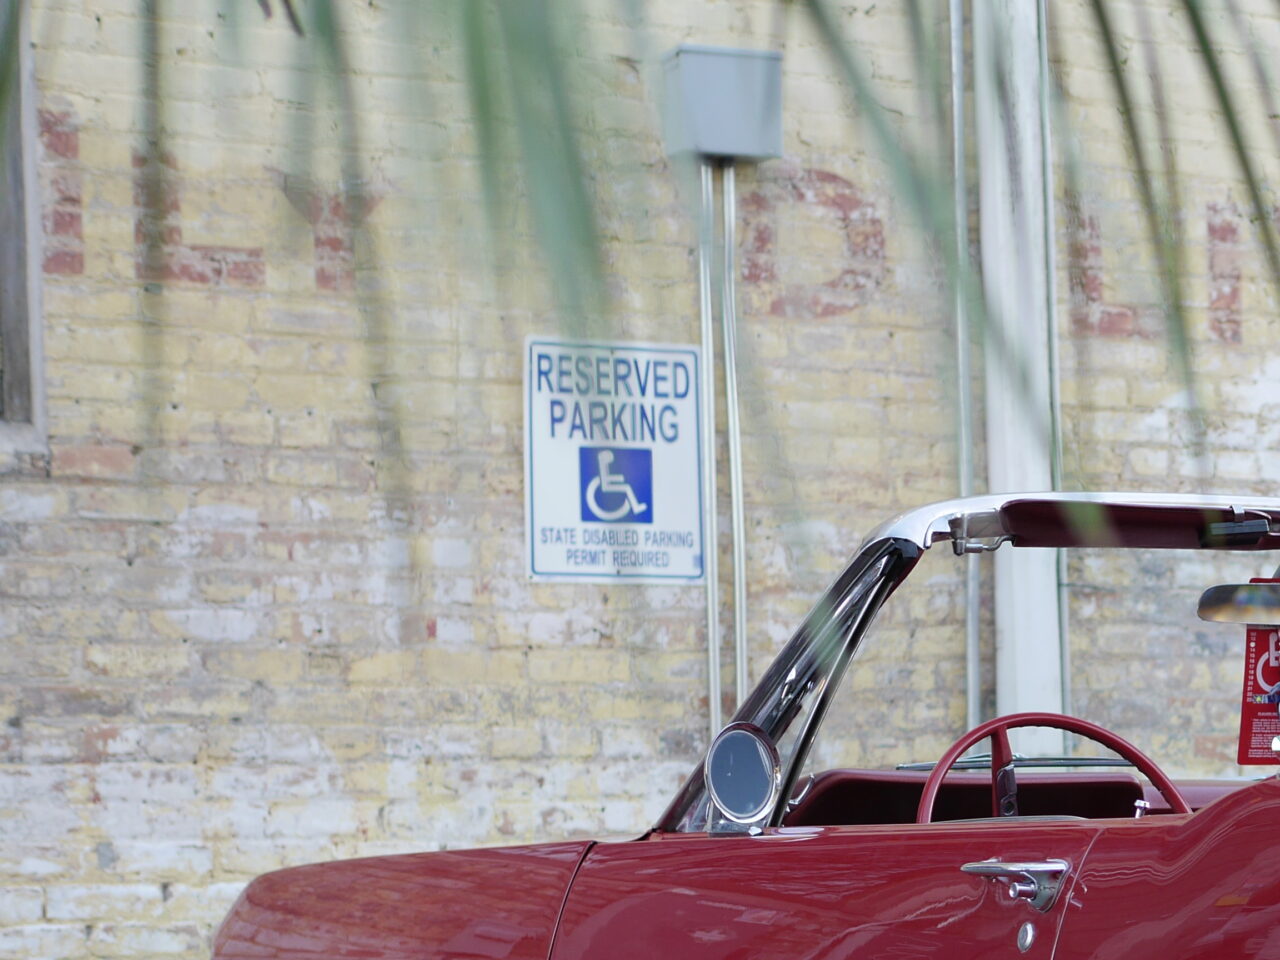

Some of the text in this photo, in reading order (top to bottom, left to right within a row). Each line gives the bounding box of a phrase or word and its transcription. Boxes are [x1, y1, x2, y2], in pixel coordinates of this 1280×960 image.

[537, 353, 690, 399] RESERVED
[550, 399, 680, 443] PARKING
[541, 527, 694, 548] STATE DISABLED PARKING
[566, 549, 670, 568] PERMIT REQUIRED
